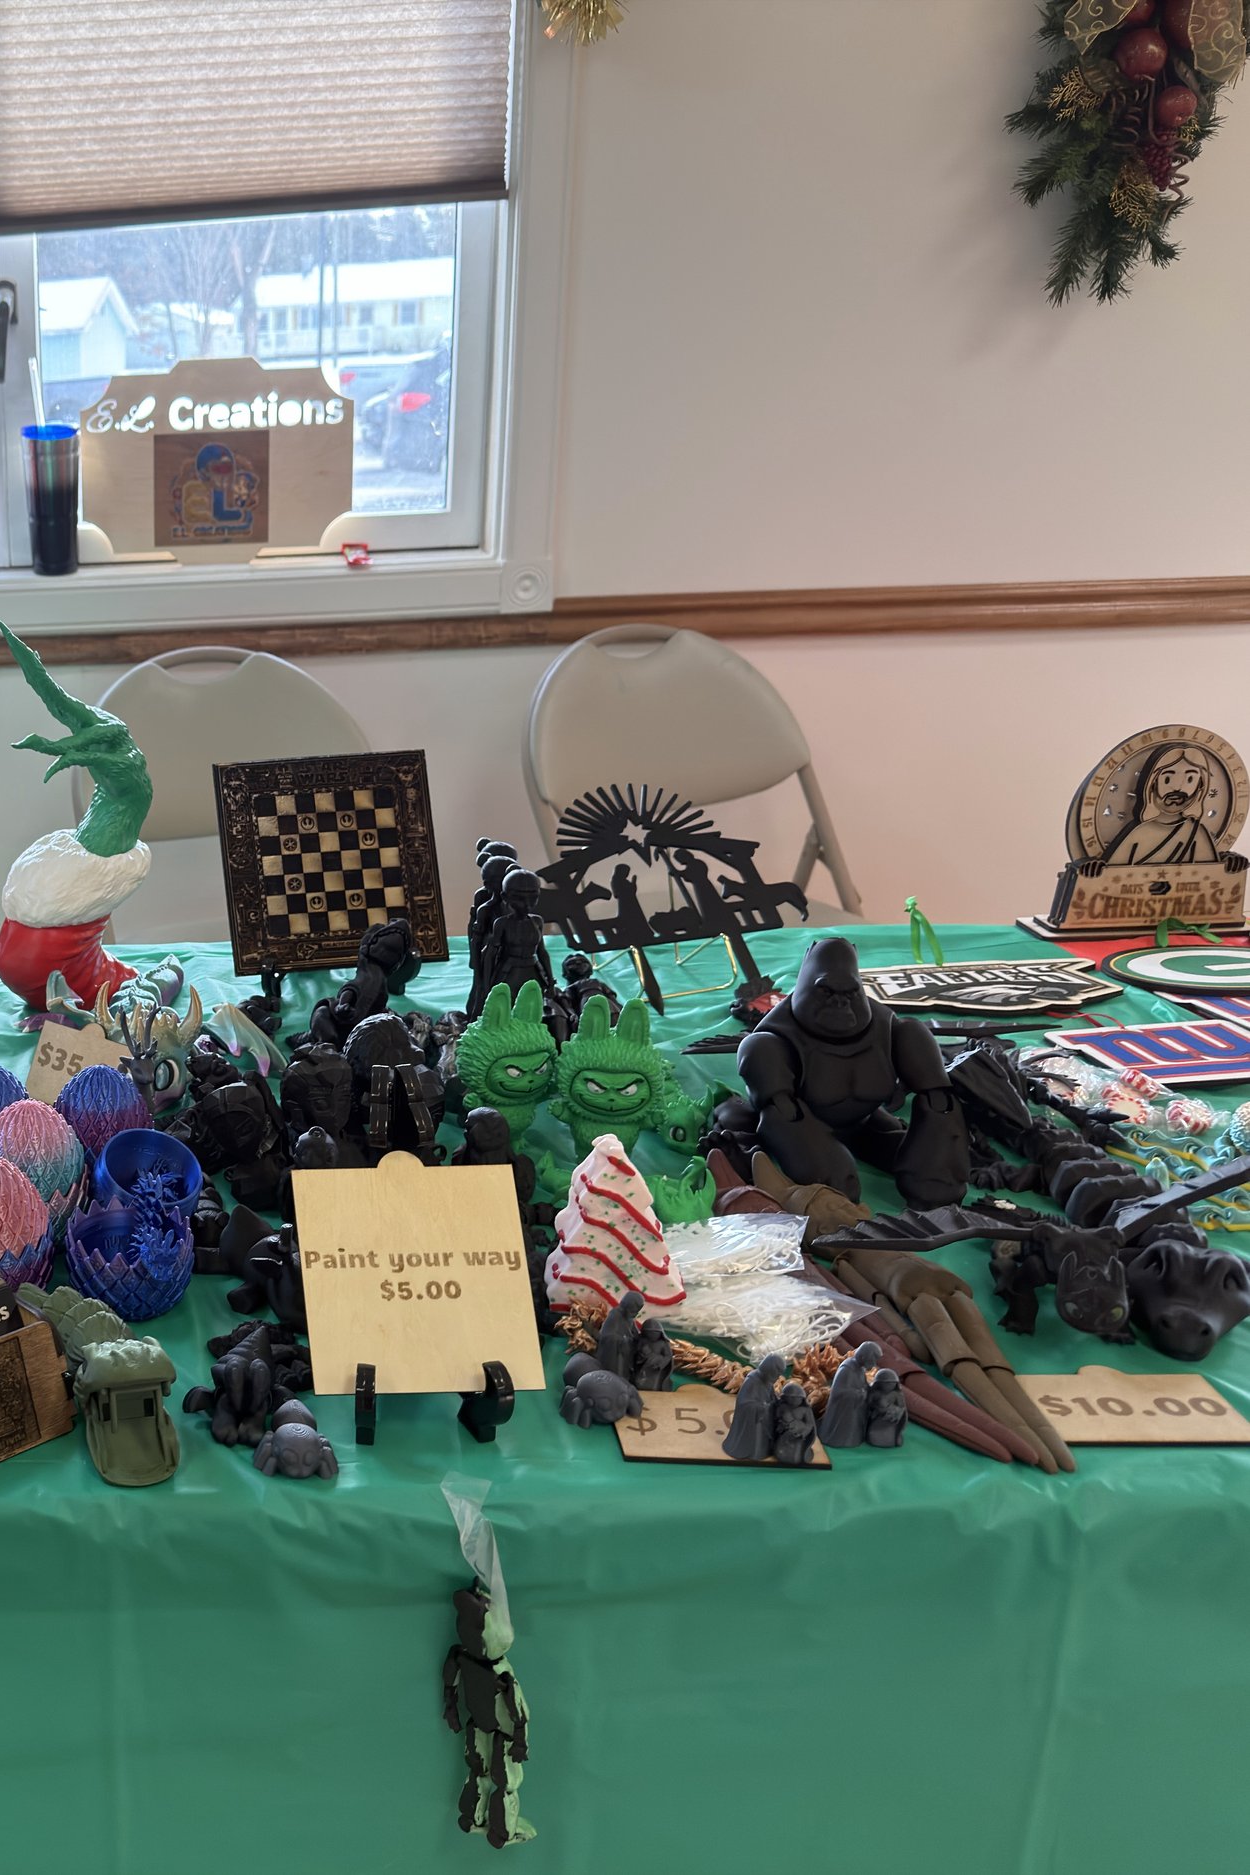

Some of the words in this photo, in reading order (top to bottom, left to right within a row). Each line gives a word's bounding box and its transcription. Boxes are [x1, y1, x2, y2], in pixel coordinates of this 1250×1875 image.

[168, 390, 344, 431] Creations
[1088, 887, 1224, 919] CHRISTMAS
[304, 1247, 380, 1269] Paint
[389, 1250, 454, 1273] your
[462, 1250, 522, 1271] way
[380, 1280, 462, 1301] $5.00
[1038, 1395, 1228, 1417] $10.00
